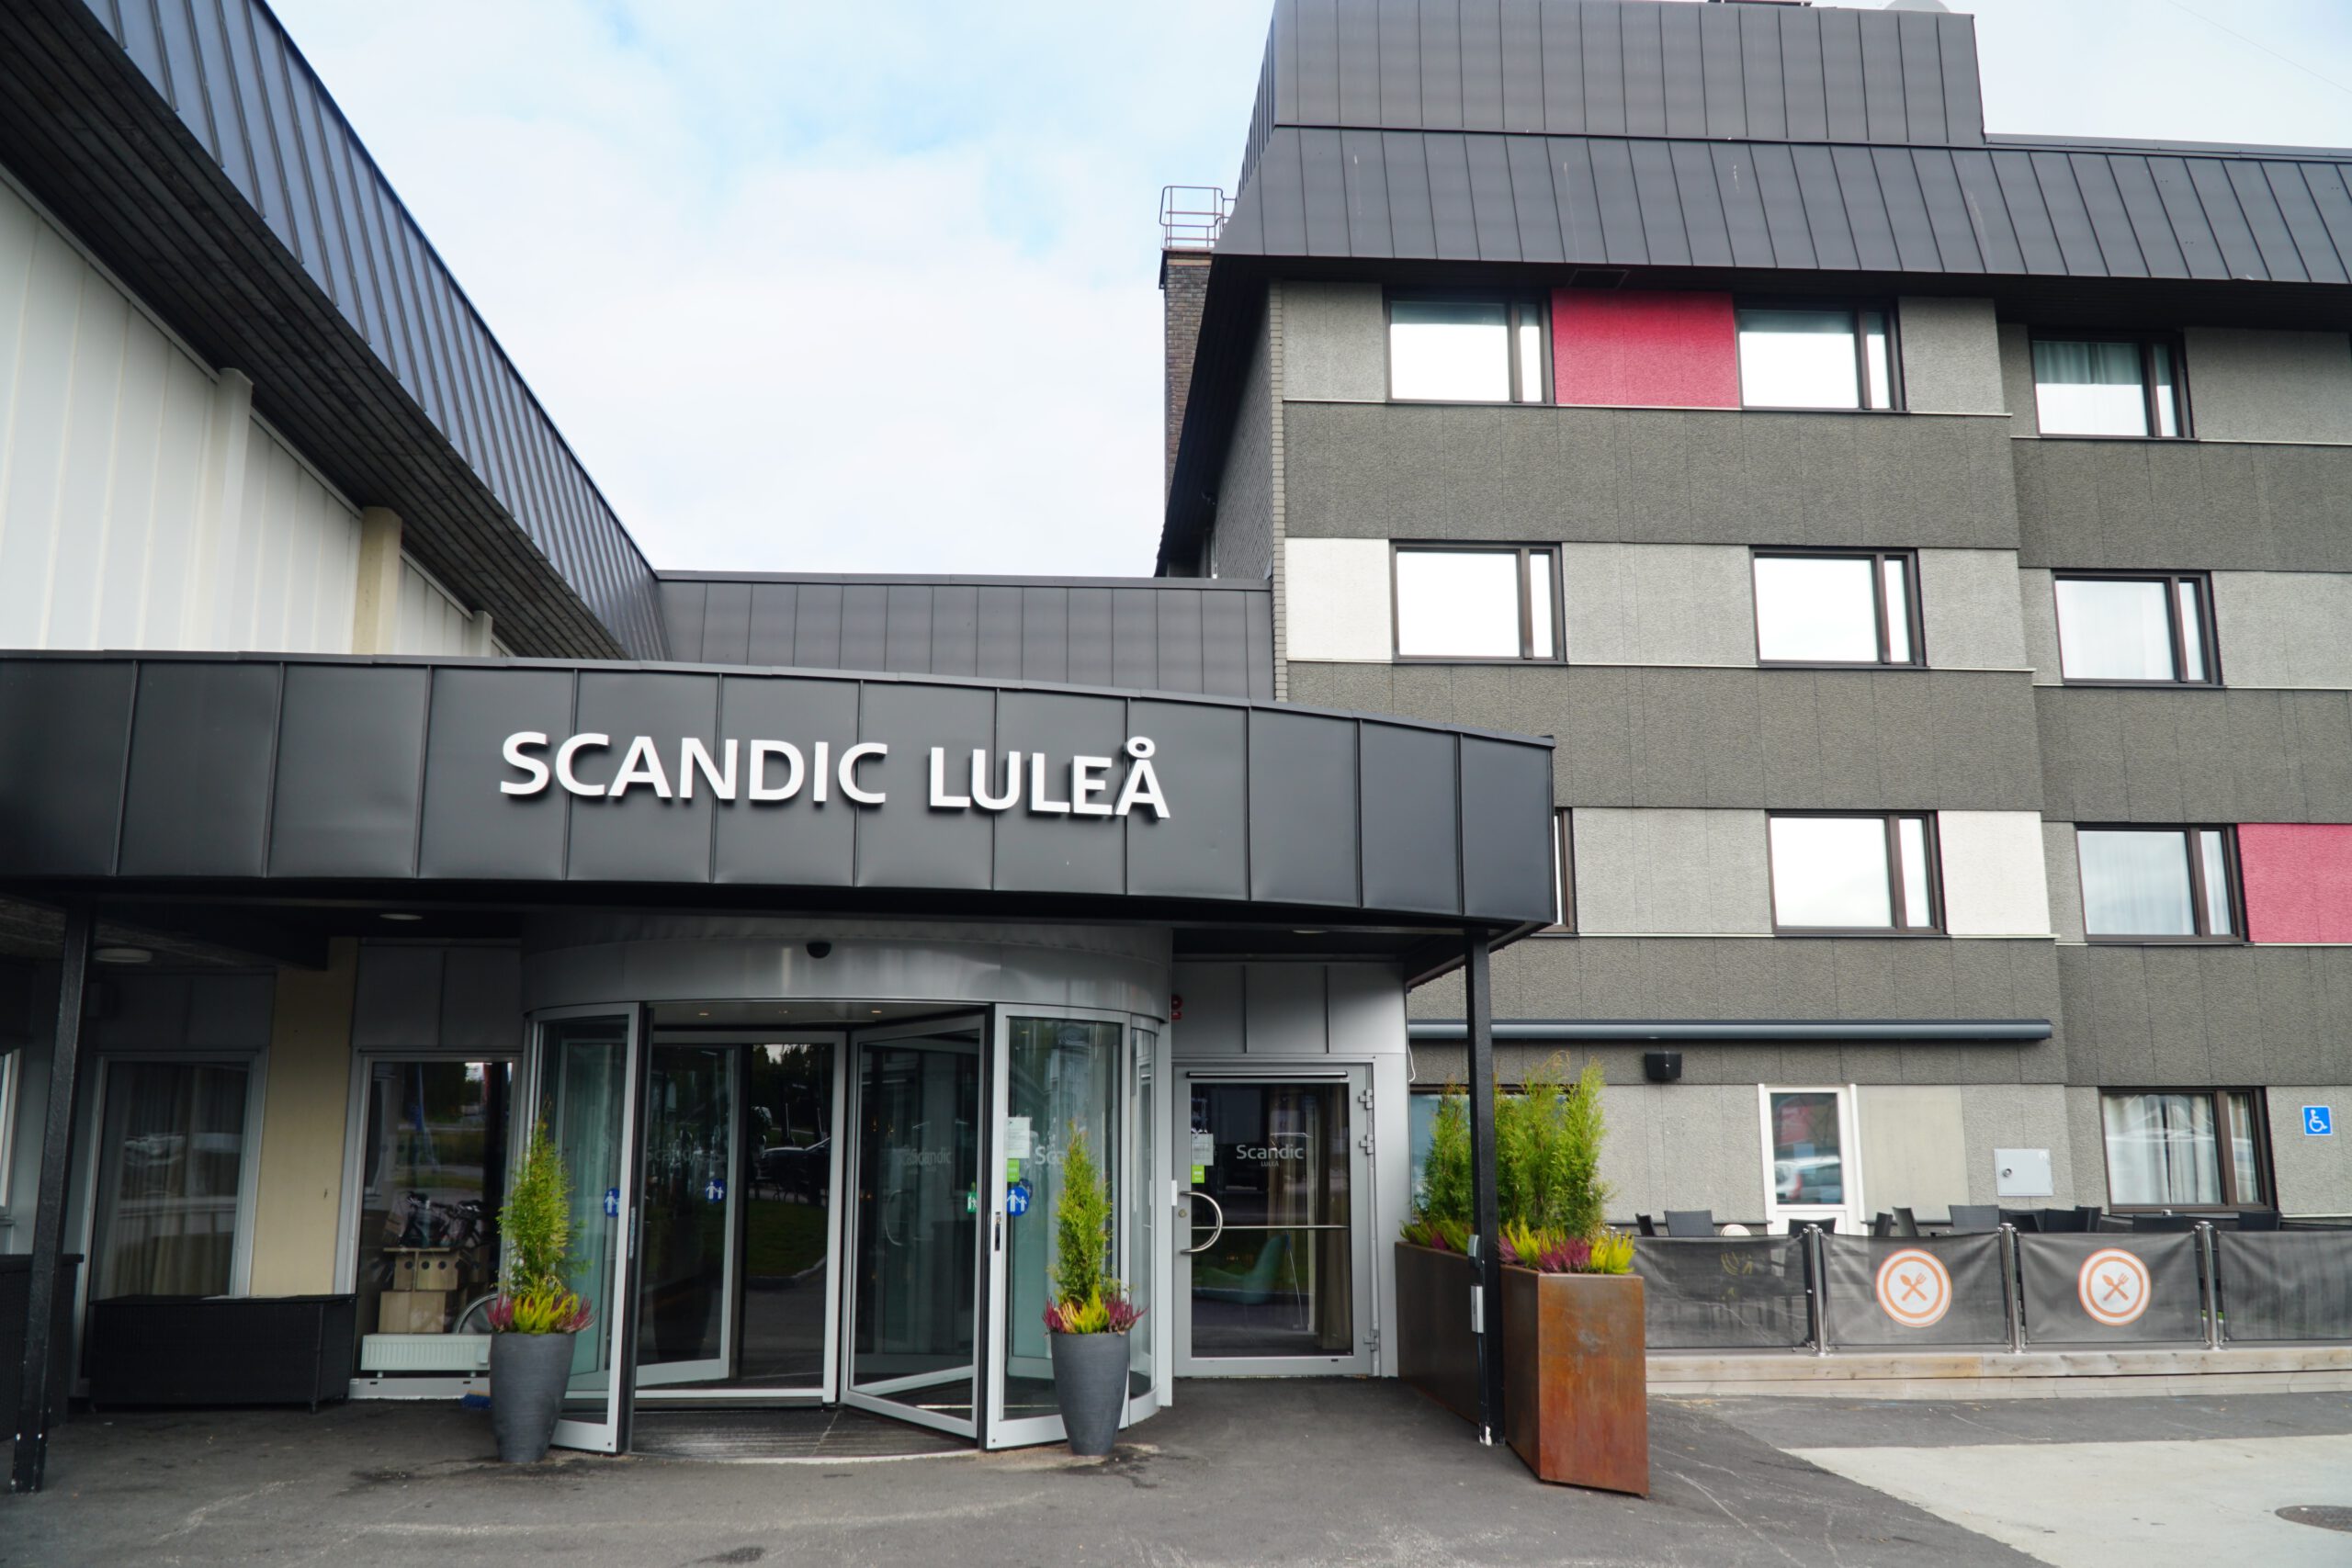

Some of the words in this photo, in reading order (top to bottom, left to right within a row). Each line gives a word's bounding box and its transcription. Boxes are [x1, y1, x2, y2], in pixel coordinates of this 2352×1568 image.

[500, 731, 888, 805] SCANDIC
[929, 736, 1170, 819] LULEÅ
[1236, 1144, 1305, 1160] Scandic
